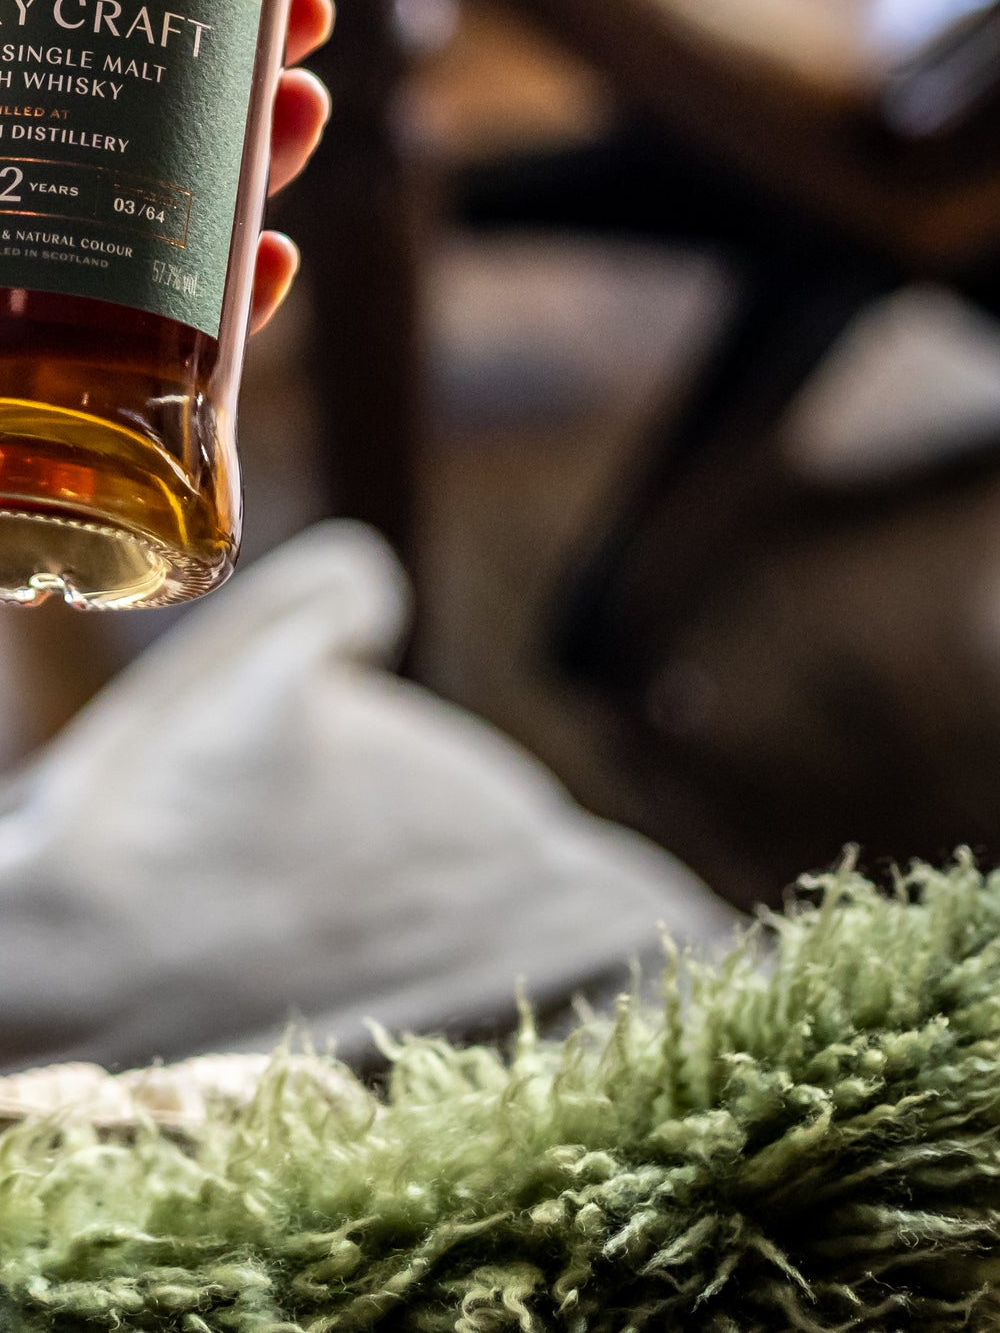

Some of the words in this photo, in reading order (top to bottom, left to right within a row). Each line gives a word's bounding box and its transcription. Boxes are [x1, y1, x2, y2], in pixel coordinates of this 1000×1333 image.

[1, 44, 95, 69] SINGLE
[103, 54, 167, 83] MALT
[23, 73, 124, 101] WHISKY
[50, 109, 70, 119] AT
[11, 124, 130, 153] DISTILLERY
[29, 182, 80, 196] YEARS
[2, 229, 11, 240] &
[16, 229, 75, 247] NATURAL
[80, 237, 133, 258] COLOUR
[25, 248, 38, 258] IN
[42, 250, 110, 268] SCOTLAND
